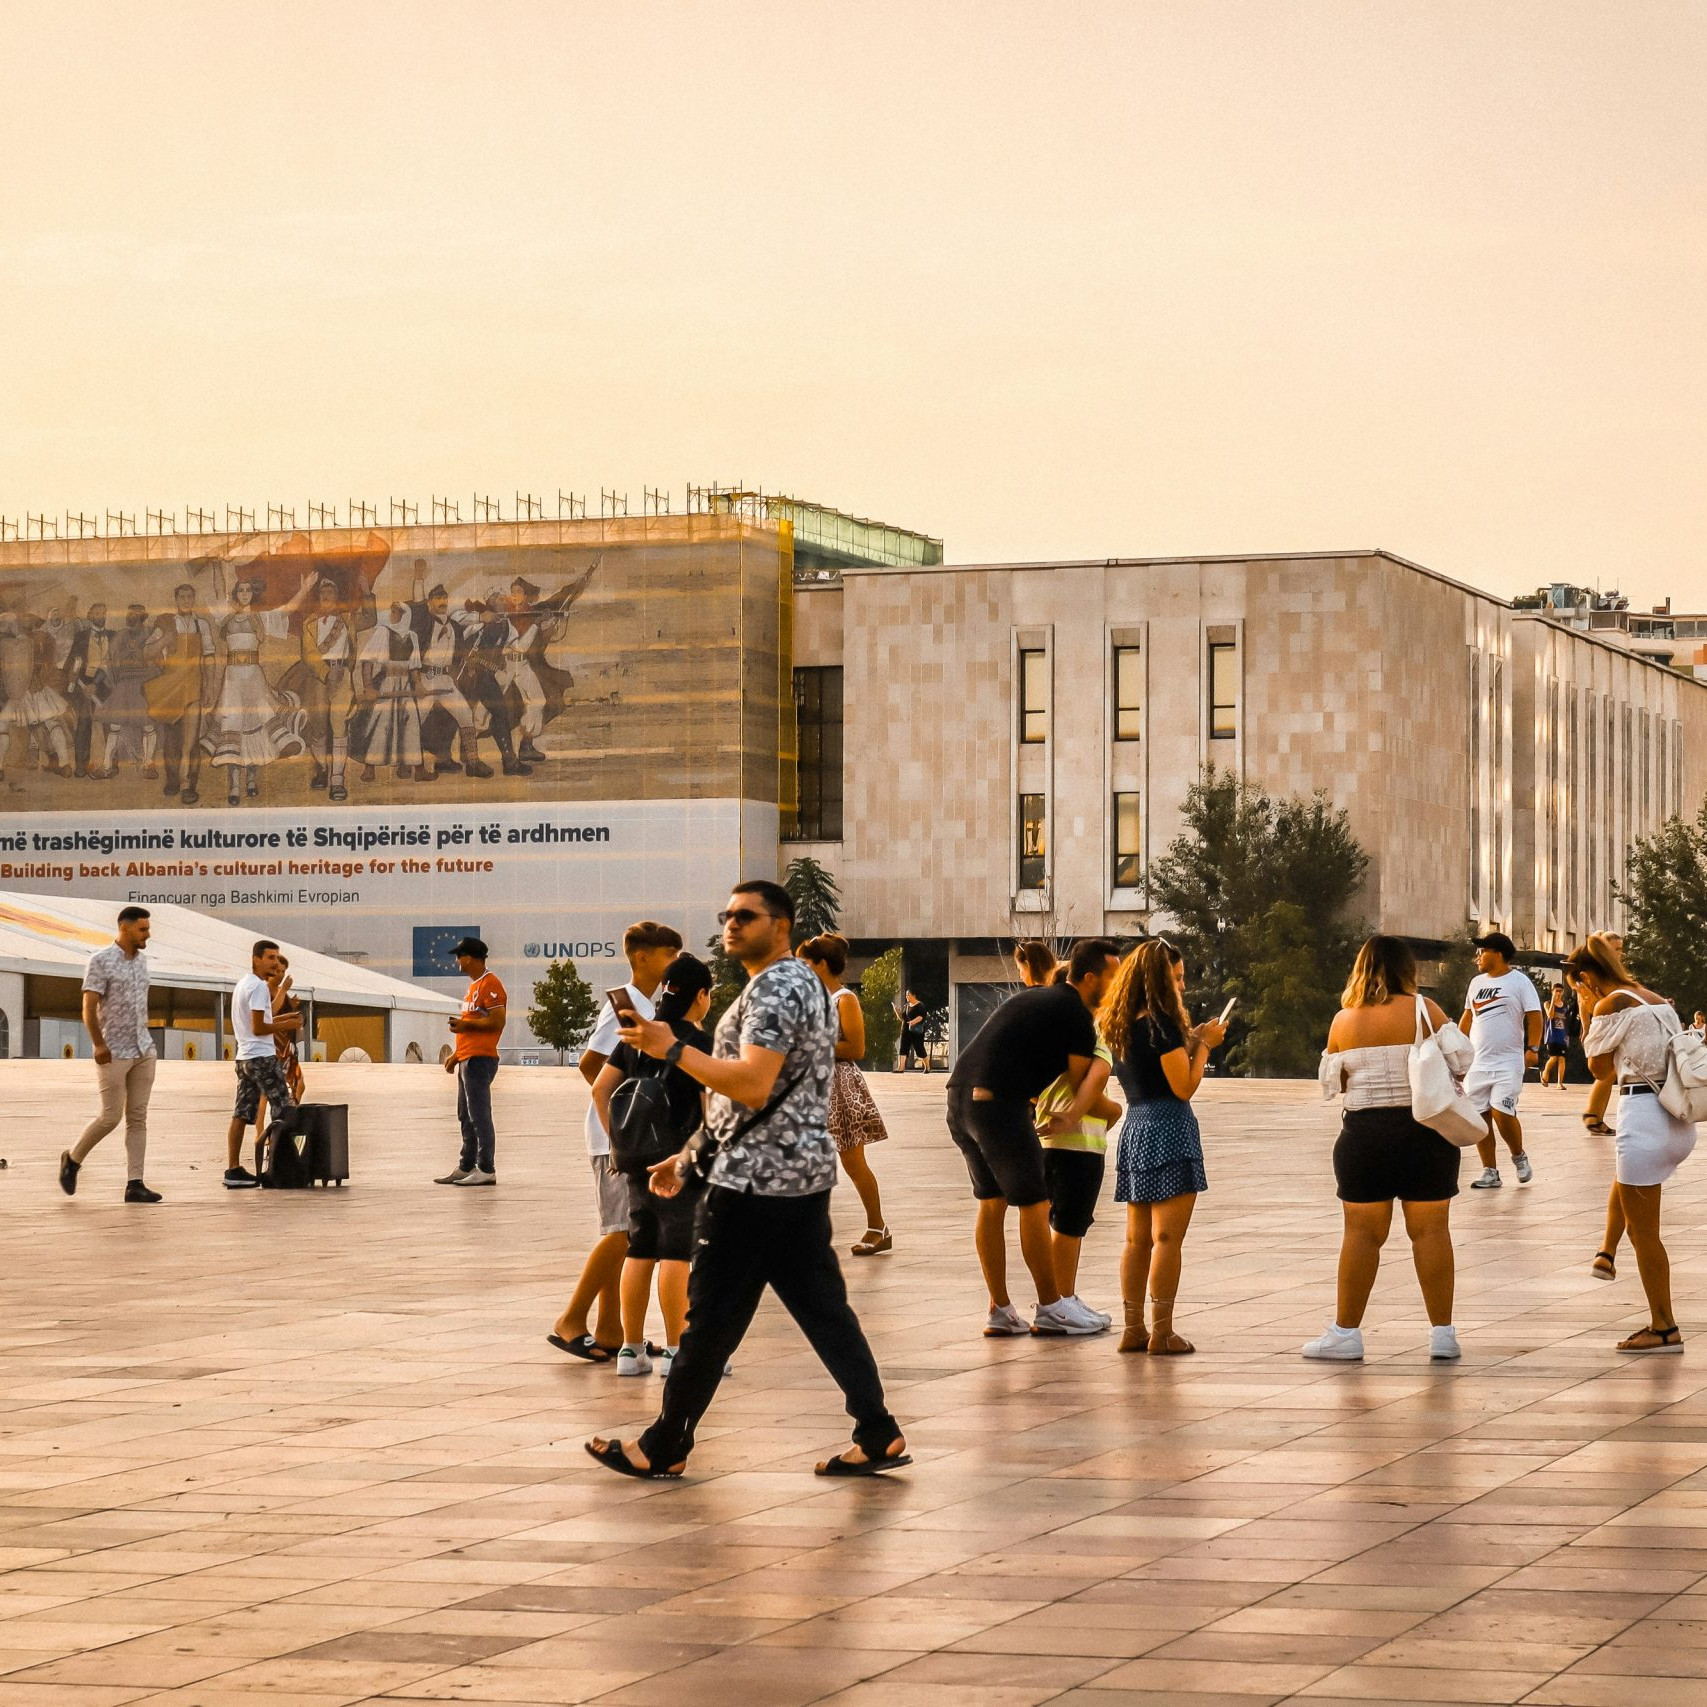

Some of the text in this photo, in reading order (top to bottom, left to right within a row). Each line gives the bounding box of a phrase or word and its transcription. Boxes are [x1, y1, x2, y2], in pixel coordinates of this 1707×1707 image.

[0, 823, 610, 854] më trashëgiminë kulturore të Shqipërisë për të ardhmen
[1, 858, 494, 881] Building back Albania's cultural heritage for the future
[128, 889, 360, 907] Financuar nga Bashkimi Evropian
[543, 942, 616, 958] UNOPS
[1475, 987, 1502, 999] NIKE
